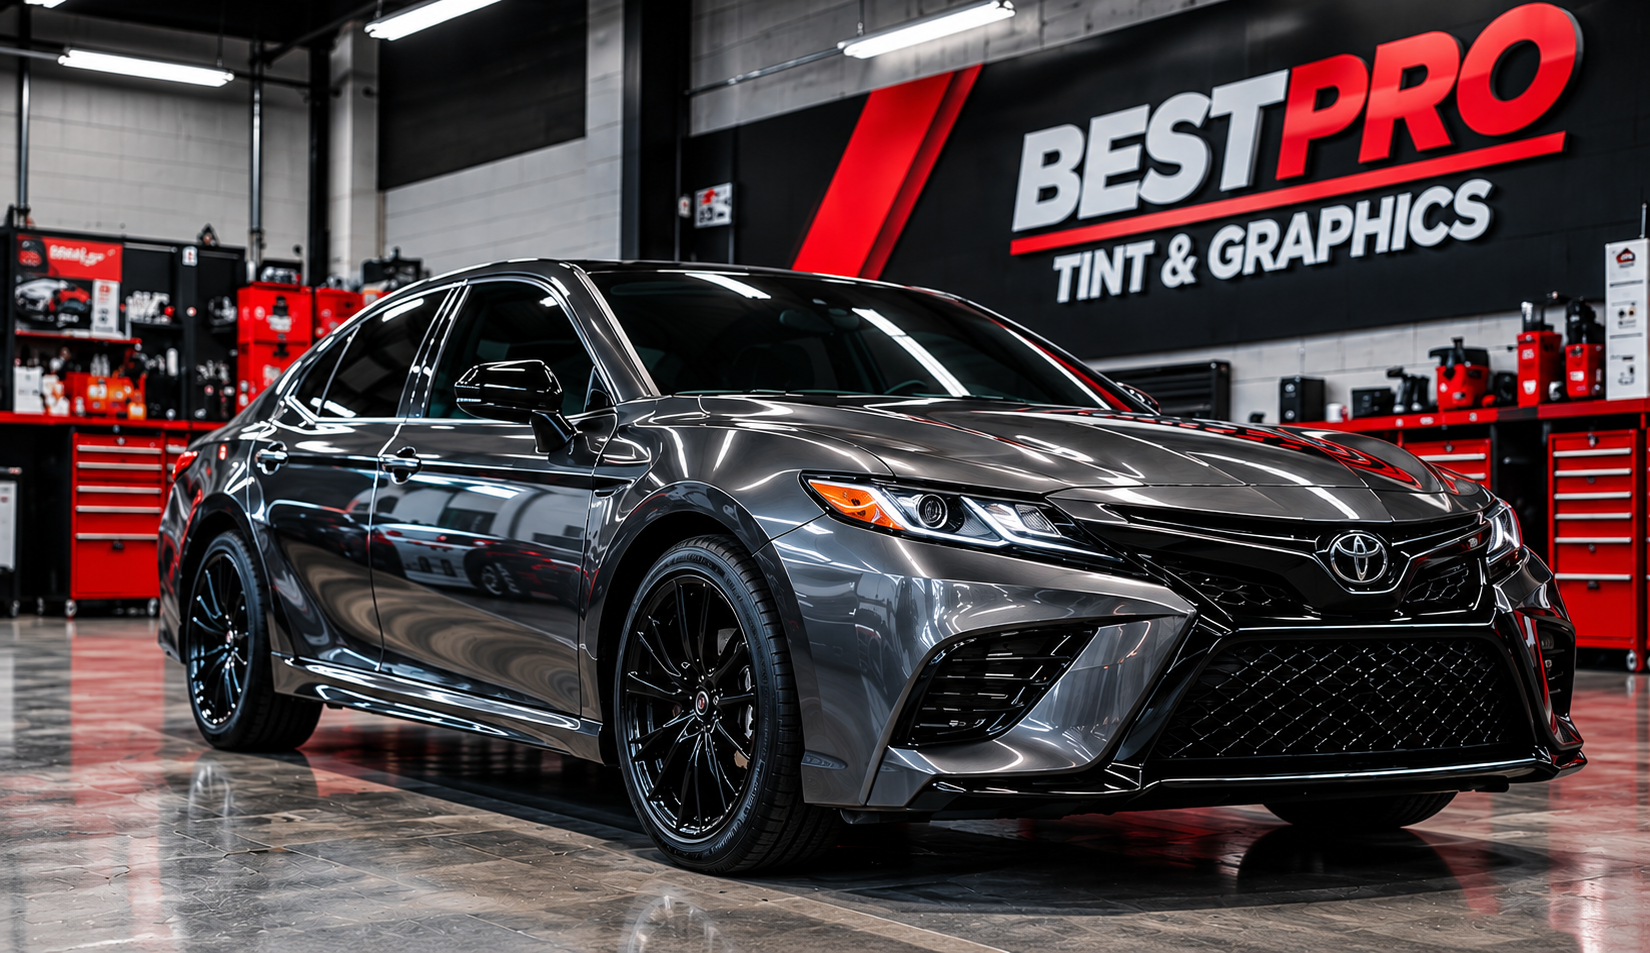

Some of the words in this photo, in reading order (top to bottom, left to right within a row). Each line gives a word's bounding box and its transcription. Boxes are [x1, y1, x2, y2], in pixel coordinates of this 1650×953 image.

[1053, 240, 1154, 303] TINT
[1160, 233, 1197, 288] &
[1208, 178, 1493, 279] GRAPHICS
